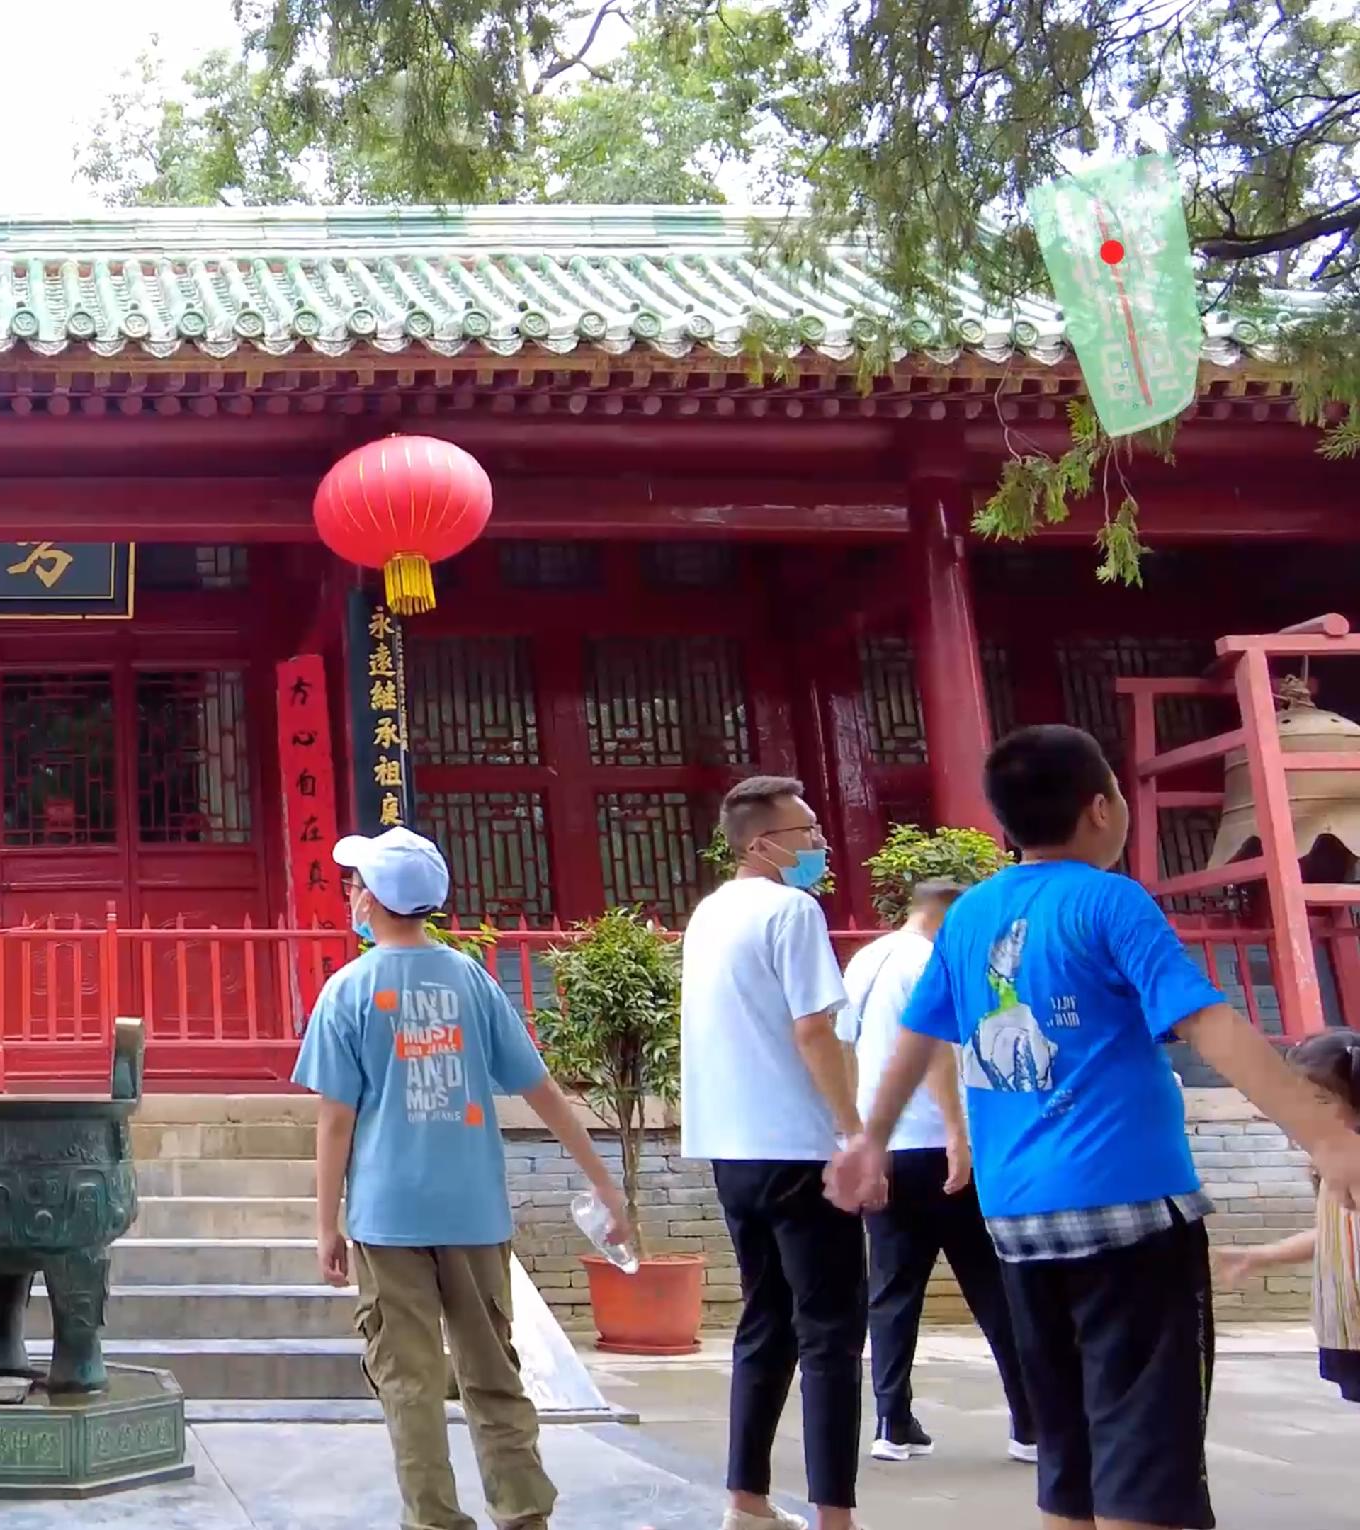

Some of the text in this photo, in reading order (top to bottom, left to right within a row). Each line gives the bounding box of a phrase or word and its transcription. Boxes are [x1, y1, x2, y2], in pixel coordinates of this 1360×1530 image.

[401, 989, 459, 1021] AND
[403, 1019, 458, 1044] MUST
[406, 1055, 463, 1088] AND
